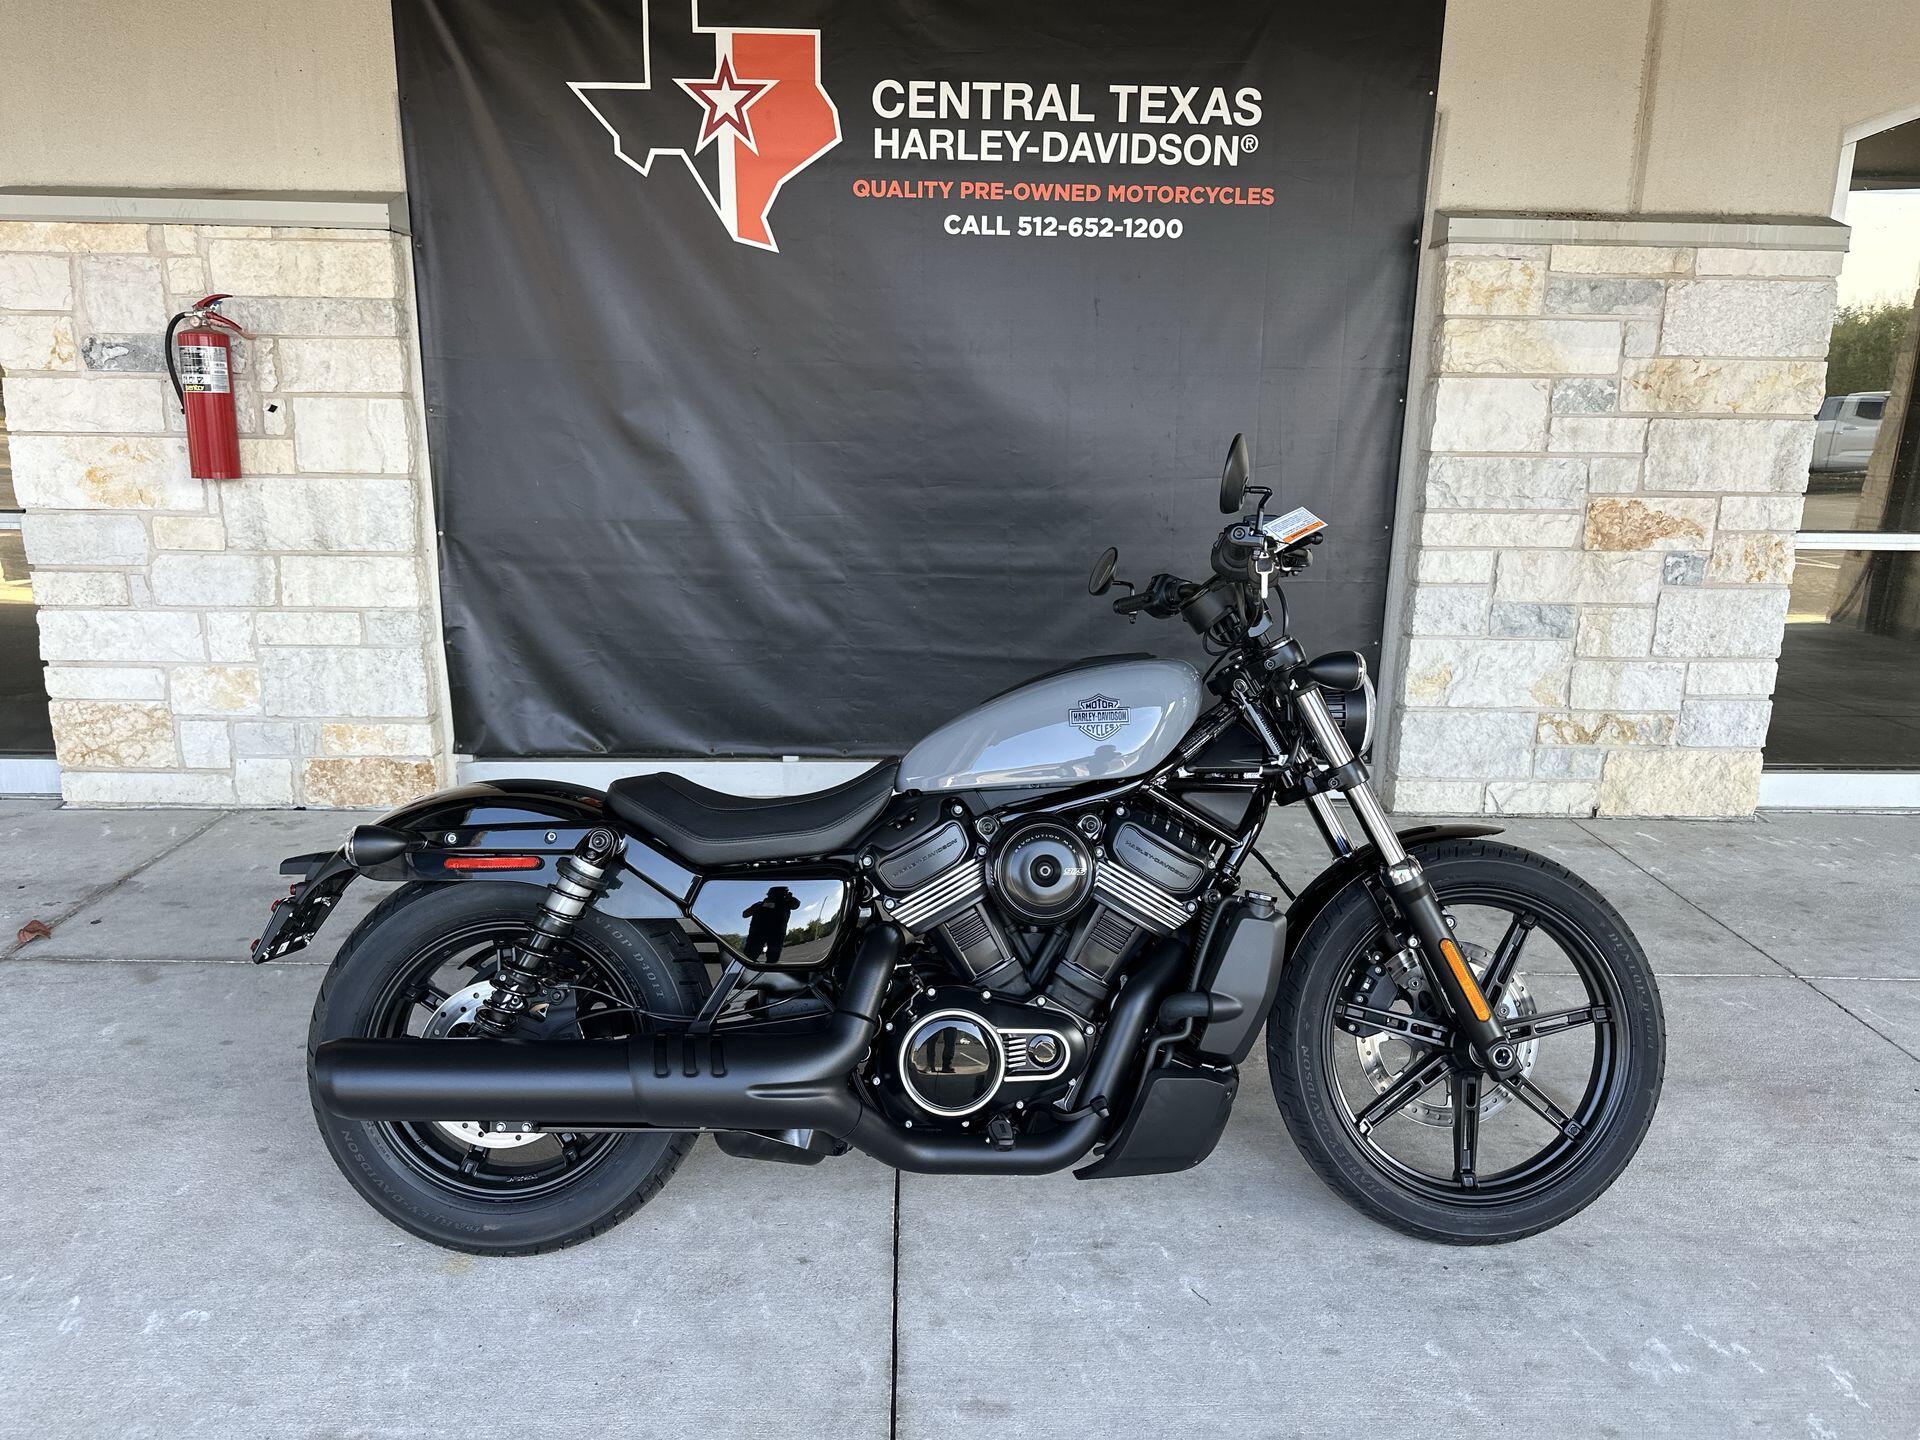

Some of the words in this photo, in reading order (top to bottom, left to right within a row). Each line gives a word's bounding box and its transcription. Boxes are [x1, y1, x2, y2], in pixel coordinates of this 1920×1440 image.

[872, 79, 1095, 123] CENTRAL
[1109, 84, 1263, 126] TEXAS
[852, 179, 955, 199] QUALITY
[960, 182, 1102, 202] PRE-OWNED
[1107, 185, 1275, 206] MOTORCYCLES
[943, 214, 1011, 236] CALL
[1016, 216, 1184, 240] 512-652-1200
[1073, 710, 1127, 722] HARLEY-DAVIDSON
[1085, 698, 1114, 710] MOTOR
[1086, 723, 1115, 736] CYCLES
[891, 838, 958, 878] HARLEY-DAVIDSON
[1124, 840, 1190, 880] HARLEY-DAVIDSON
